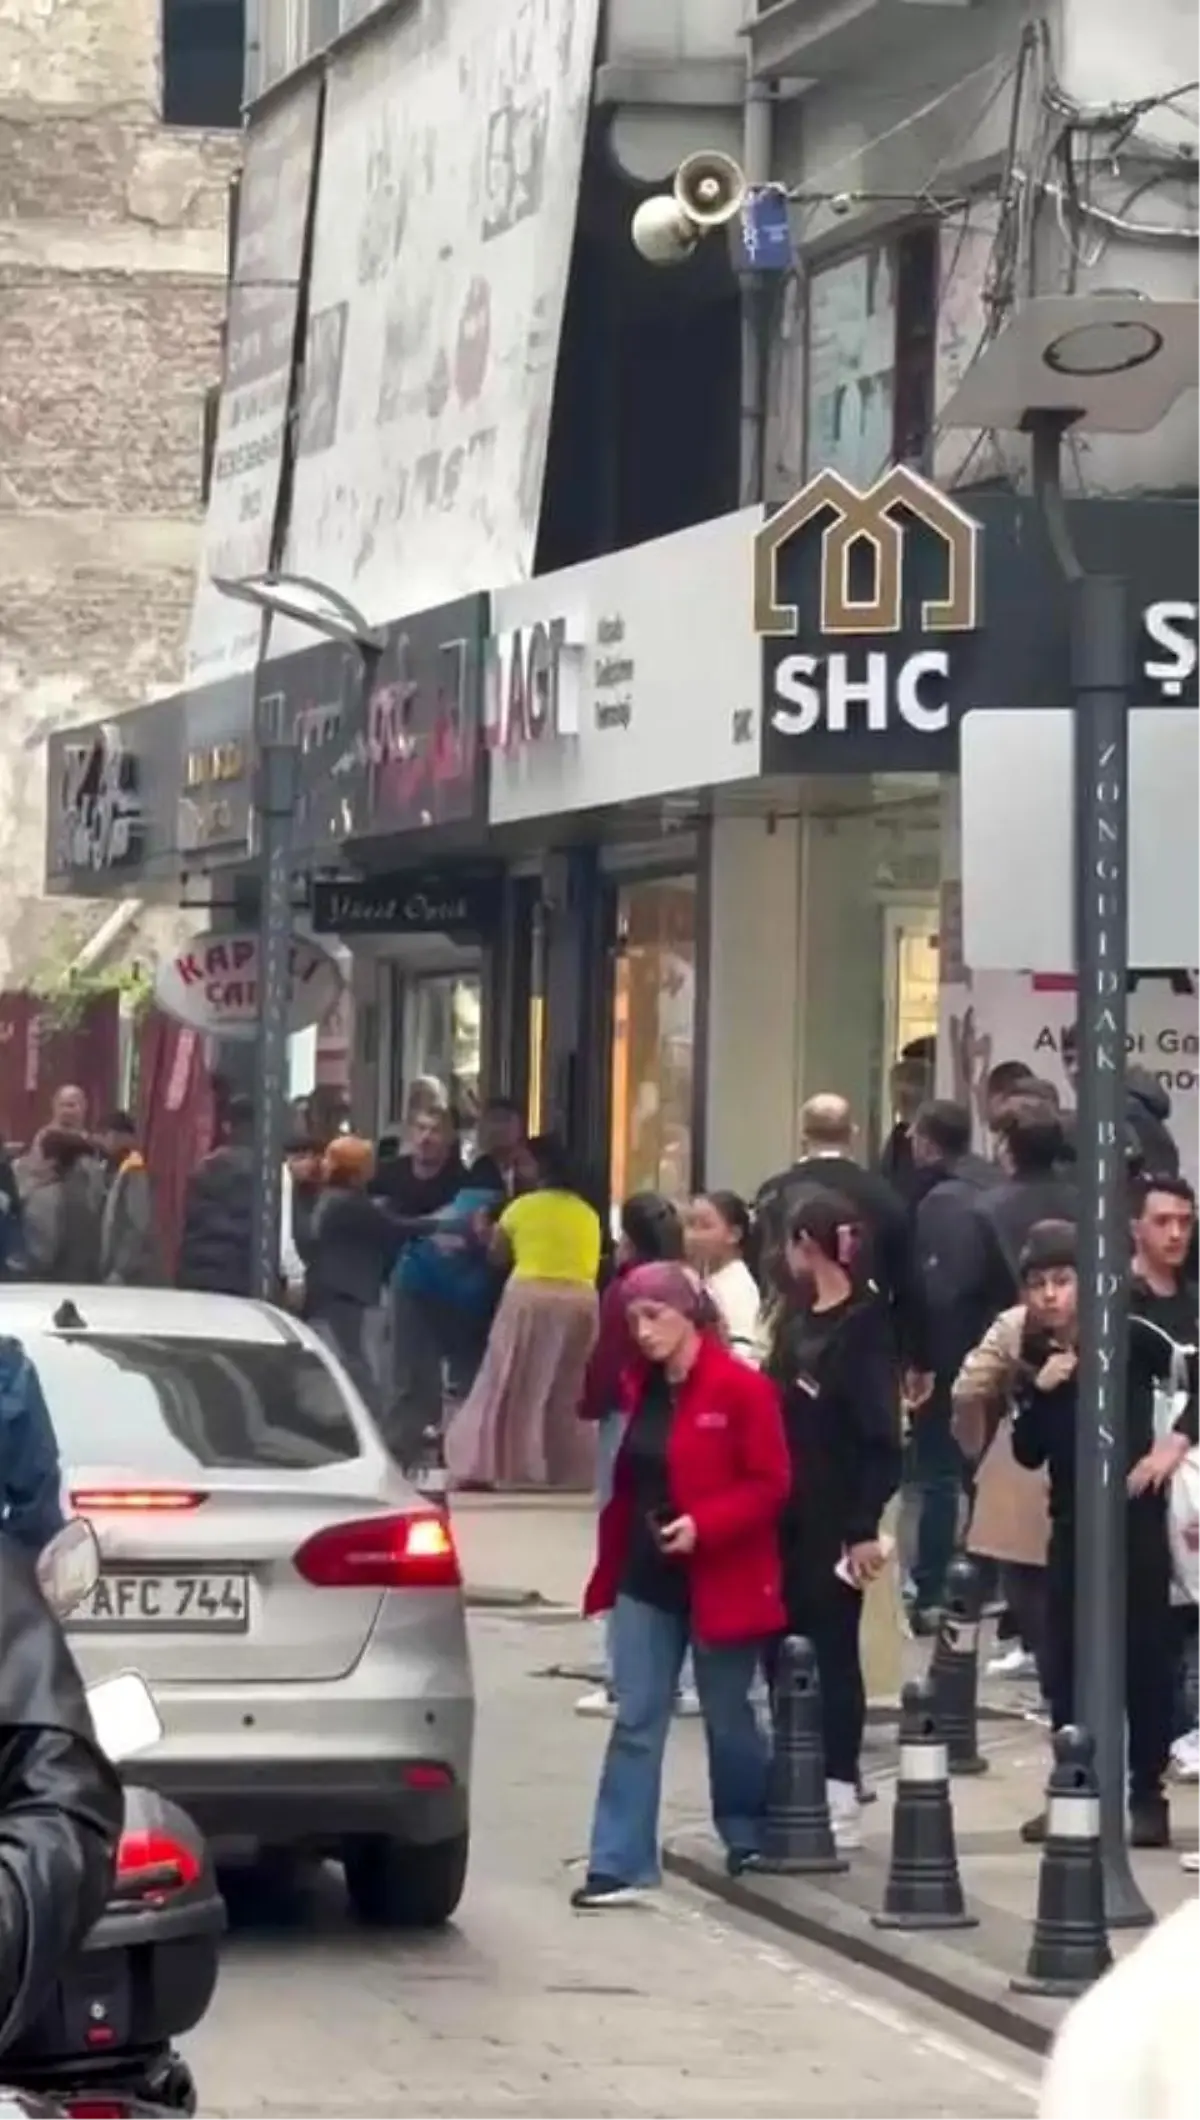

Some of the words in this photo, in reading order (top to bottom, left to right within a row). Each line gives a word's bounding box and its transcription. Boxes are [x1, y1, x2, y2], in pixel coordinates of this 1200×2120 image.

[772, 651, 949, 735] SHC
[174, 940, 319, 985] KAPLI
[91, 1579, 160, 1616] AFC
[174, 1579, 242, 1616] 744
